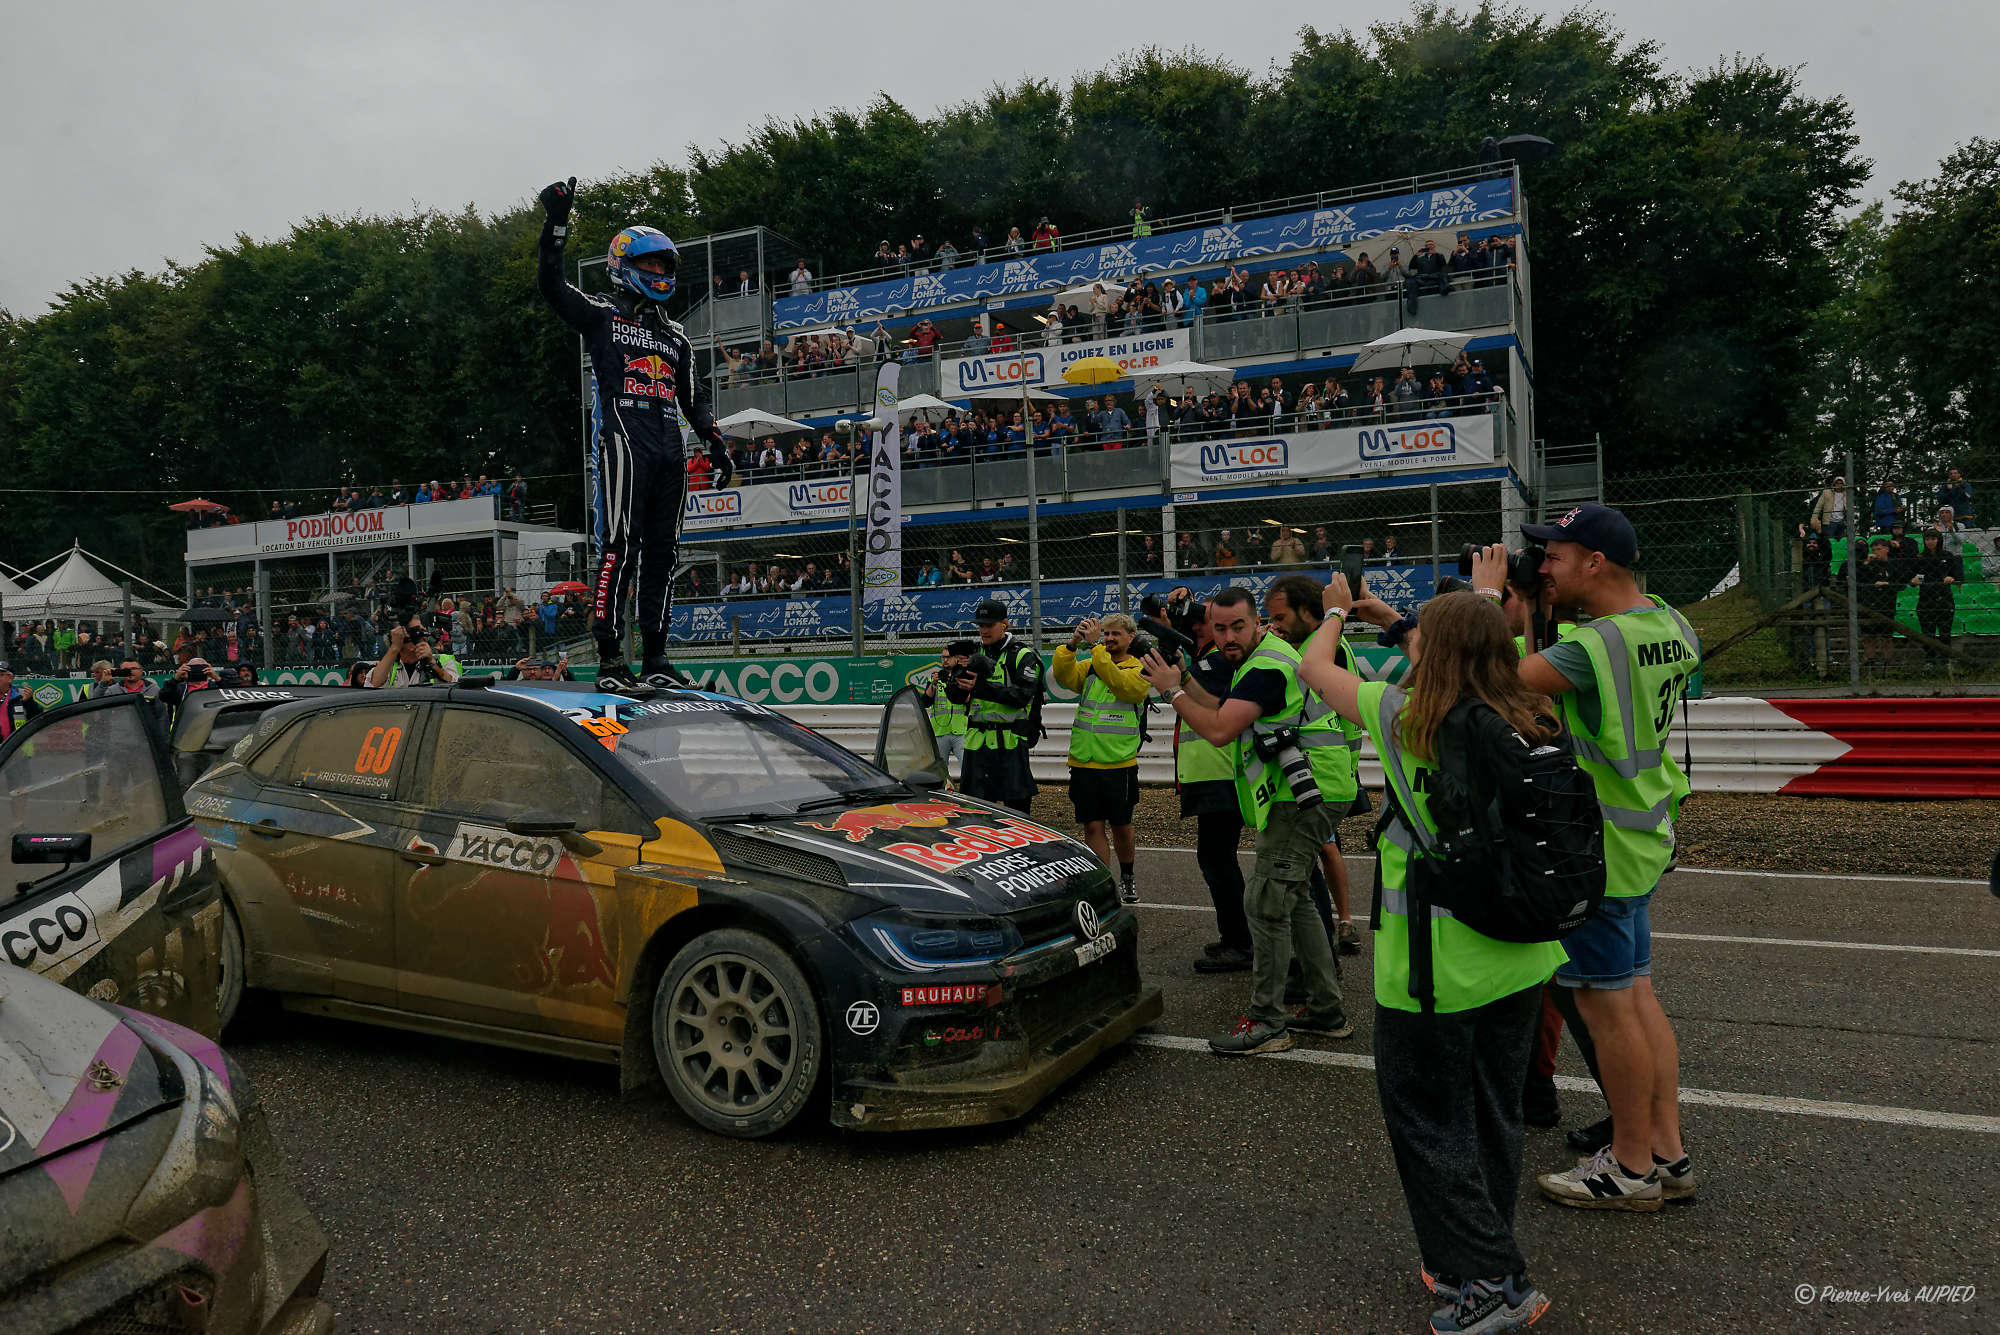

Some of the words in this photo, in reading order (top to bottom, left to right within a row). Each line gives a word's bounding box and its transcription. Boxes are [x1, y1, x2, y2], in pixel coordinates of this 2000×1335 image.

[611, 321, 653, 340] HORSE
[1060, 346, 1106, 363] LOUEZ
[1109, 344, 1128, 357] EN
[1132, 337, 1174, 354] LIGNE
[624, 377, 658, 396] Red
[1201, 444, 1279, 466] M-LOC
[1358, 429, 1441, 453] M-LOC
[869, 421, 894, 555] YACCO
[287, 511, 385, 541] PODIOCOM
[261, 540, 295, 553] LOCATION
[297, 540, 305, 549] DE
[596, 552, 617, 619] BAUHAUS
[680, 661, 839, 702] YACCO
[355, 726, 402, 774] 60
[317, 769, 392, 788] KRISTOFFERSSON
[460, 833, 555, 870] YACCO
[880, 828, 985, 873] Red
[972, 852, 1039, 881] HORSE
[996, 856, 1098, 898] POWERTRAIN
[2, 905, 88, 968] CCO
[902, 984, 987, 1004] BAUHAUS
[848, 1006, 877, 1028] ZF
